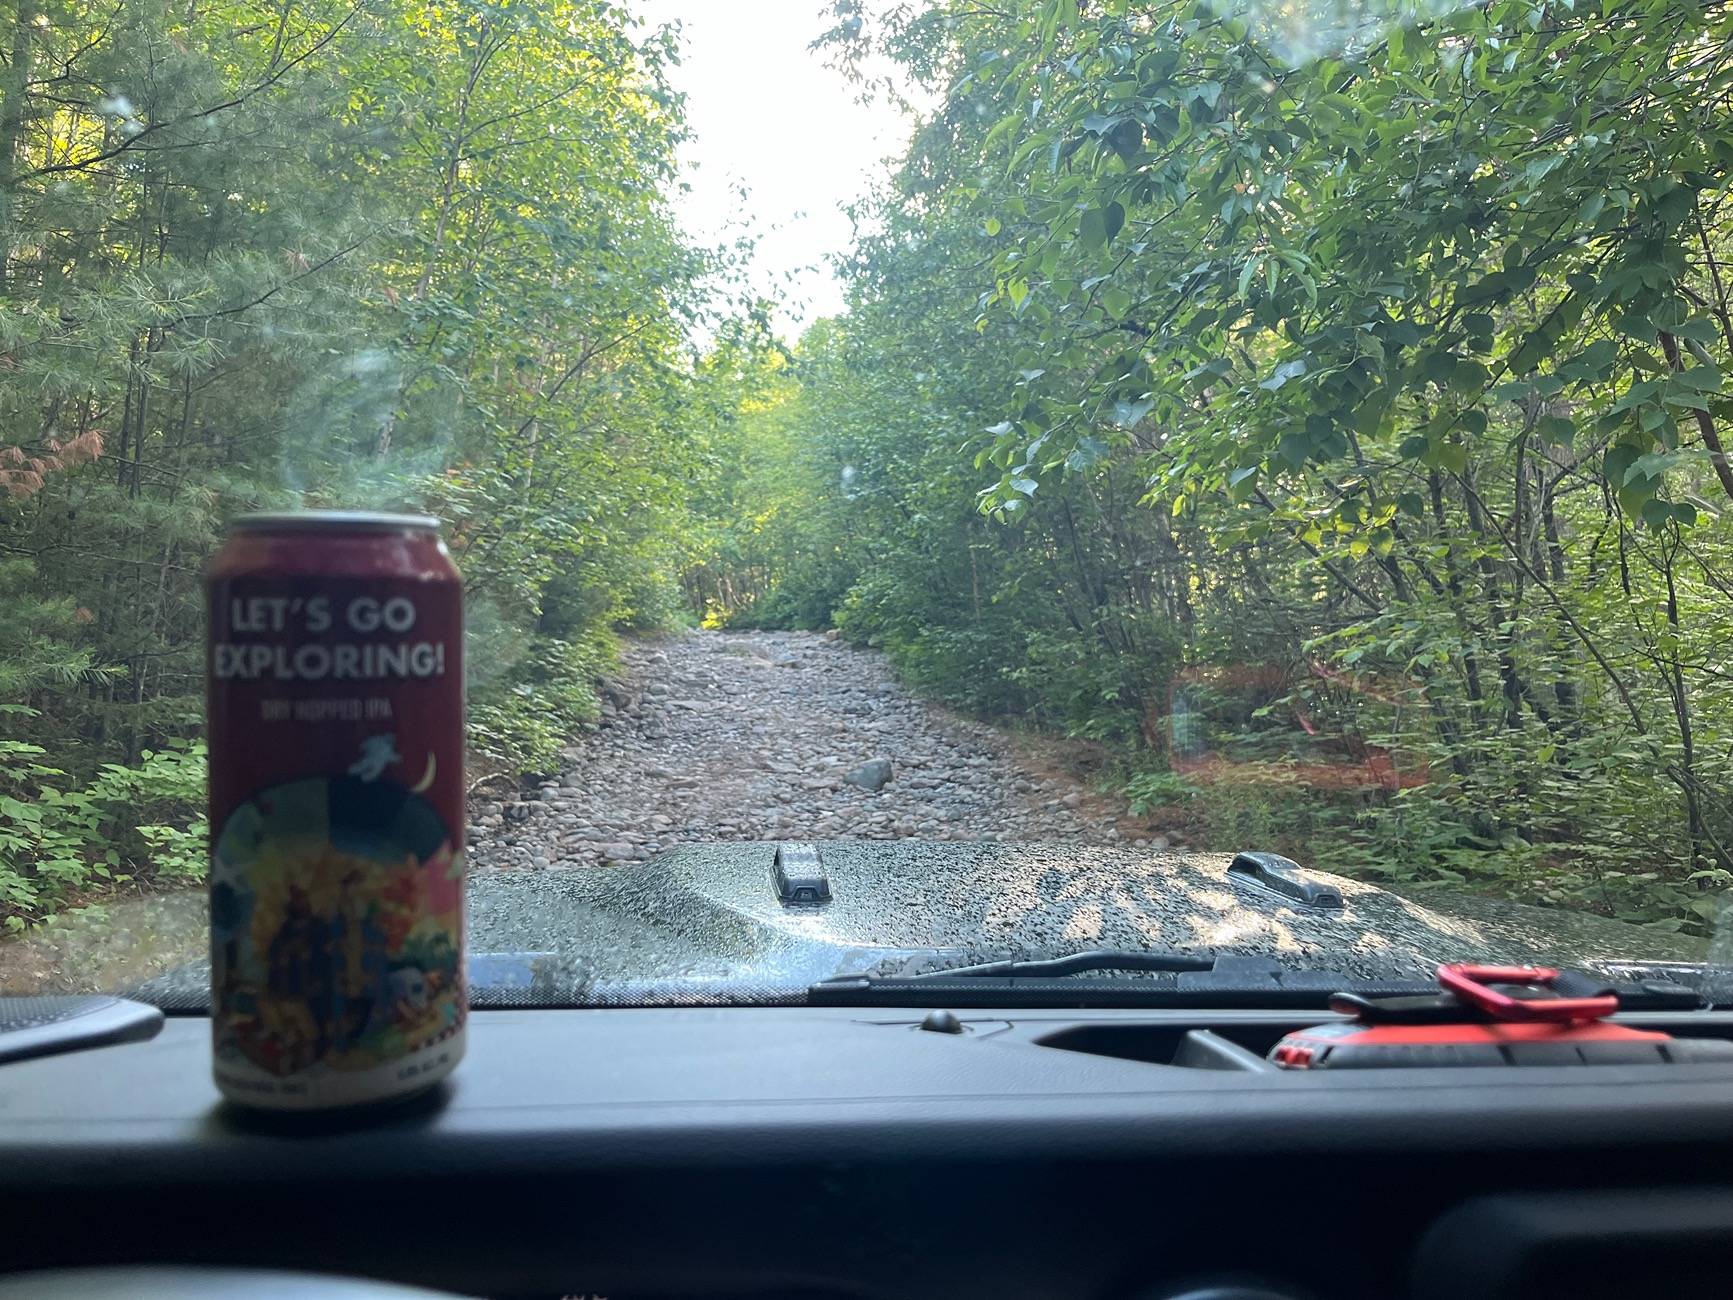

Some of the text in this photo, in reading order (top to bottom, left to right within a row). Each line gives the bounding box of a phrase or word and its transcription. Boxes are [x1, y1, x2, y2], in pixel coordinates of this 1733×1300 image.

[231, 597, 416, 633] LET'S GO
[213, 641, 446, 679] EXPLORING!
